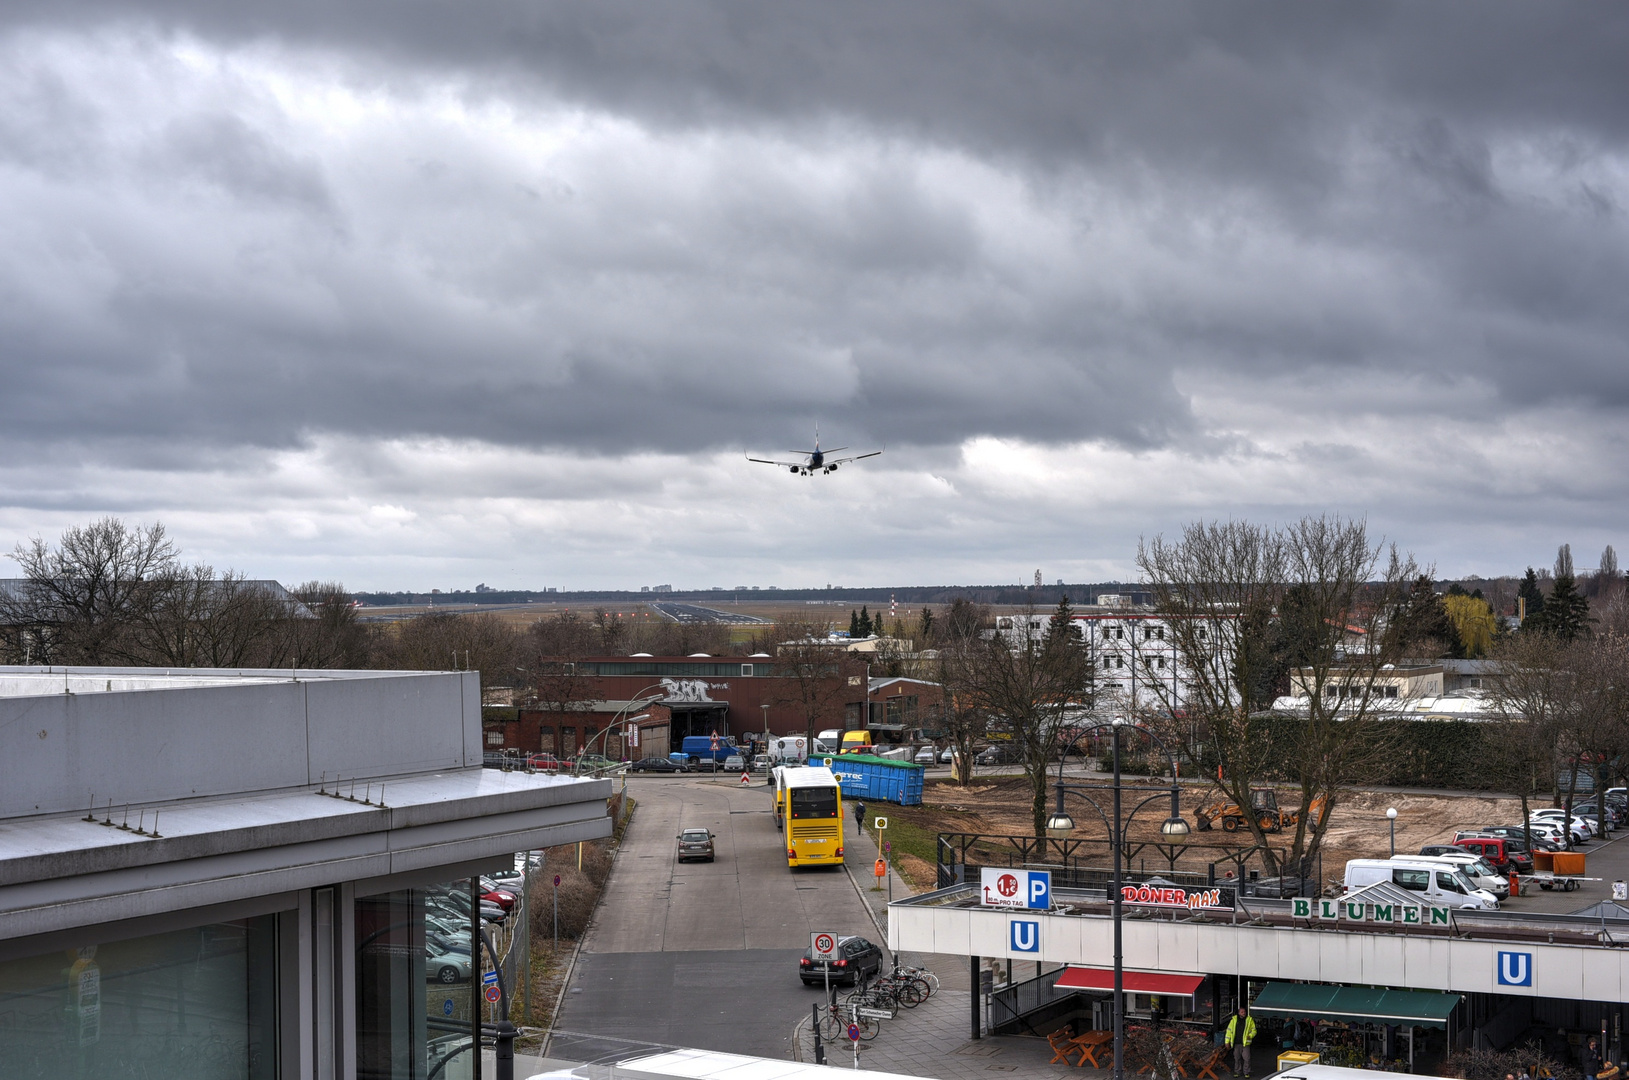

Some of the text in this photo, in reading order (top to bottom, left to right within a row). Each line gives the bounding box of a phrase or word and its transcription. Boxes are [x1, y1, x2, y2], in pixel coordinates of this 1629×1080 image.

[1031, 880, 1046, 902] P
[1121, 883, 1221, 909] DÖNER MAX
[1293, 899, 1449, 925] BLUMEN
[819, 939, 830, 948] 30
[1015, 923, 1034, 950] U
[1502, 954, 1527, 984] U
